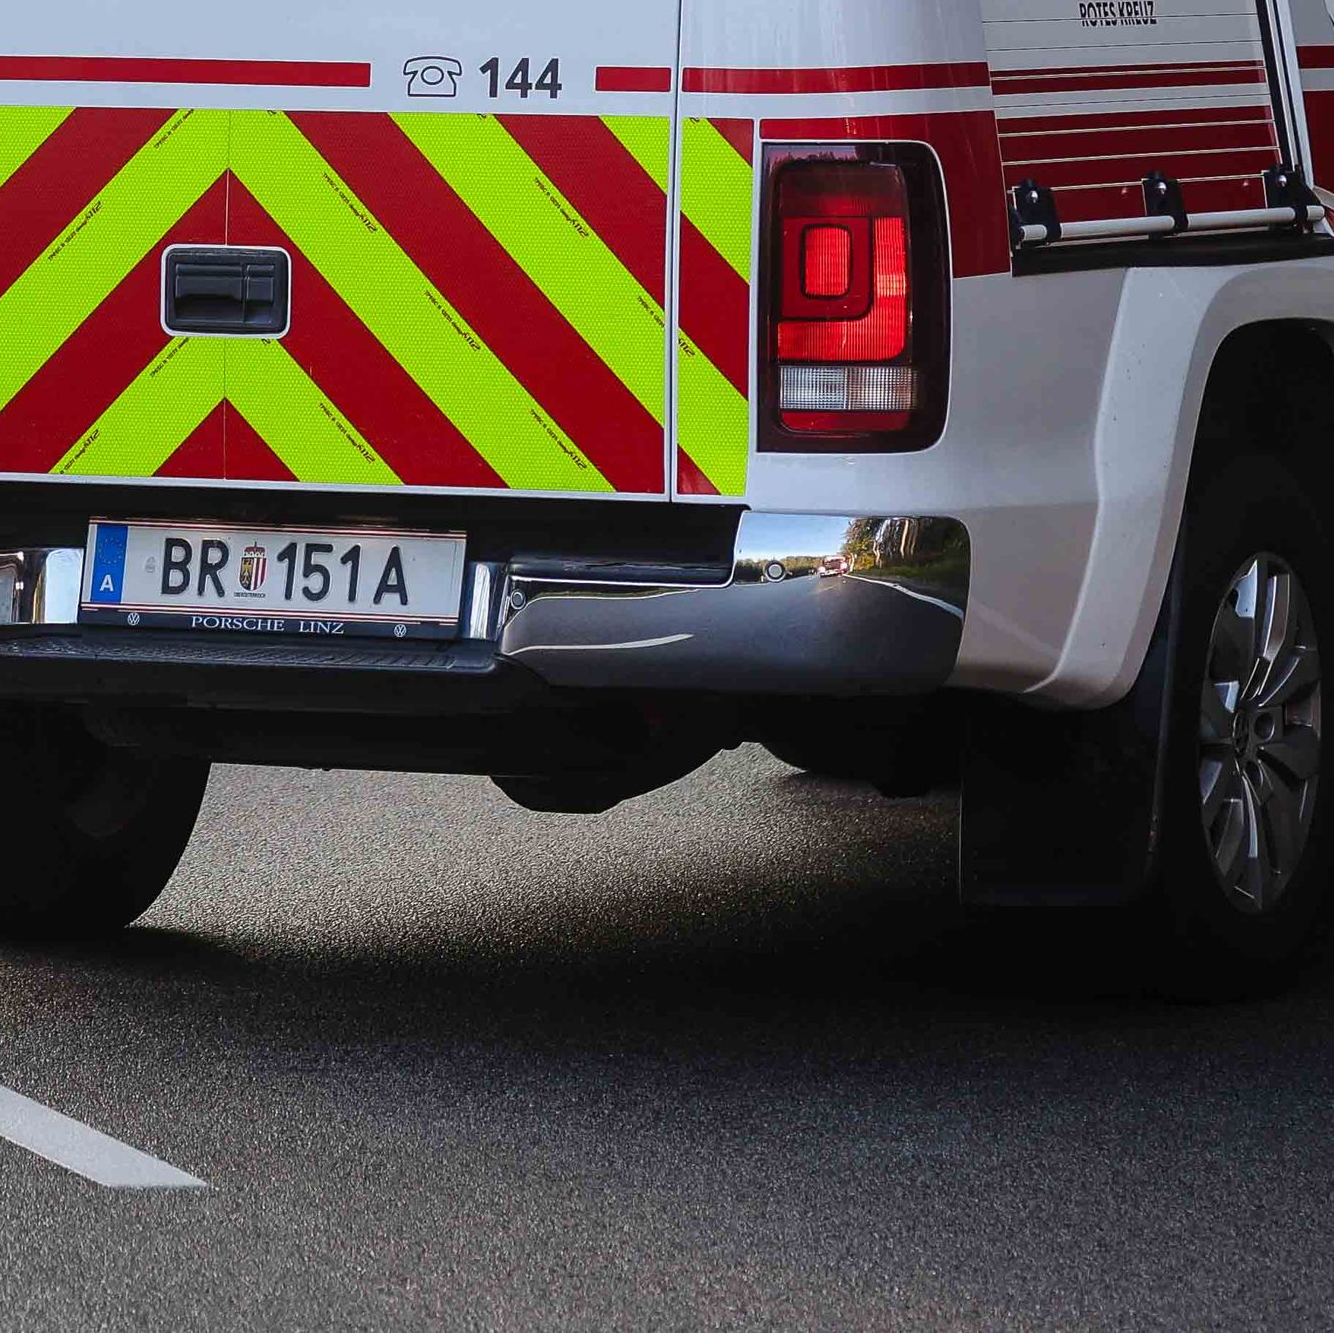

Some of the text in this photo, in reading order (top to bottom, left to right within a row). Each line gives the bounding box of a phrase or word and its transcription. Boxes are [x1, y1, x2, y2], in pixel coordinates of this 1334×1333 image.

[1079, 0, 1157, 26] ROTES KREUZ
[479, 57, 563, 99] 144
[161, 537, 230, 598] BR
[99, 574, 114, 592] A
[191, 616, 345, 635] PORSCHE LINZ
